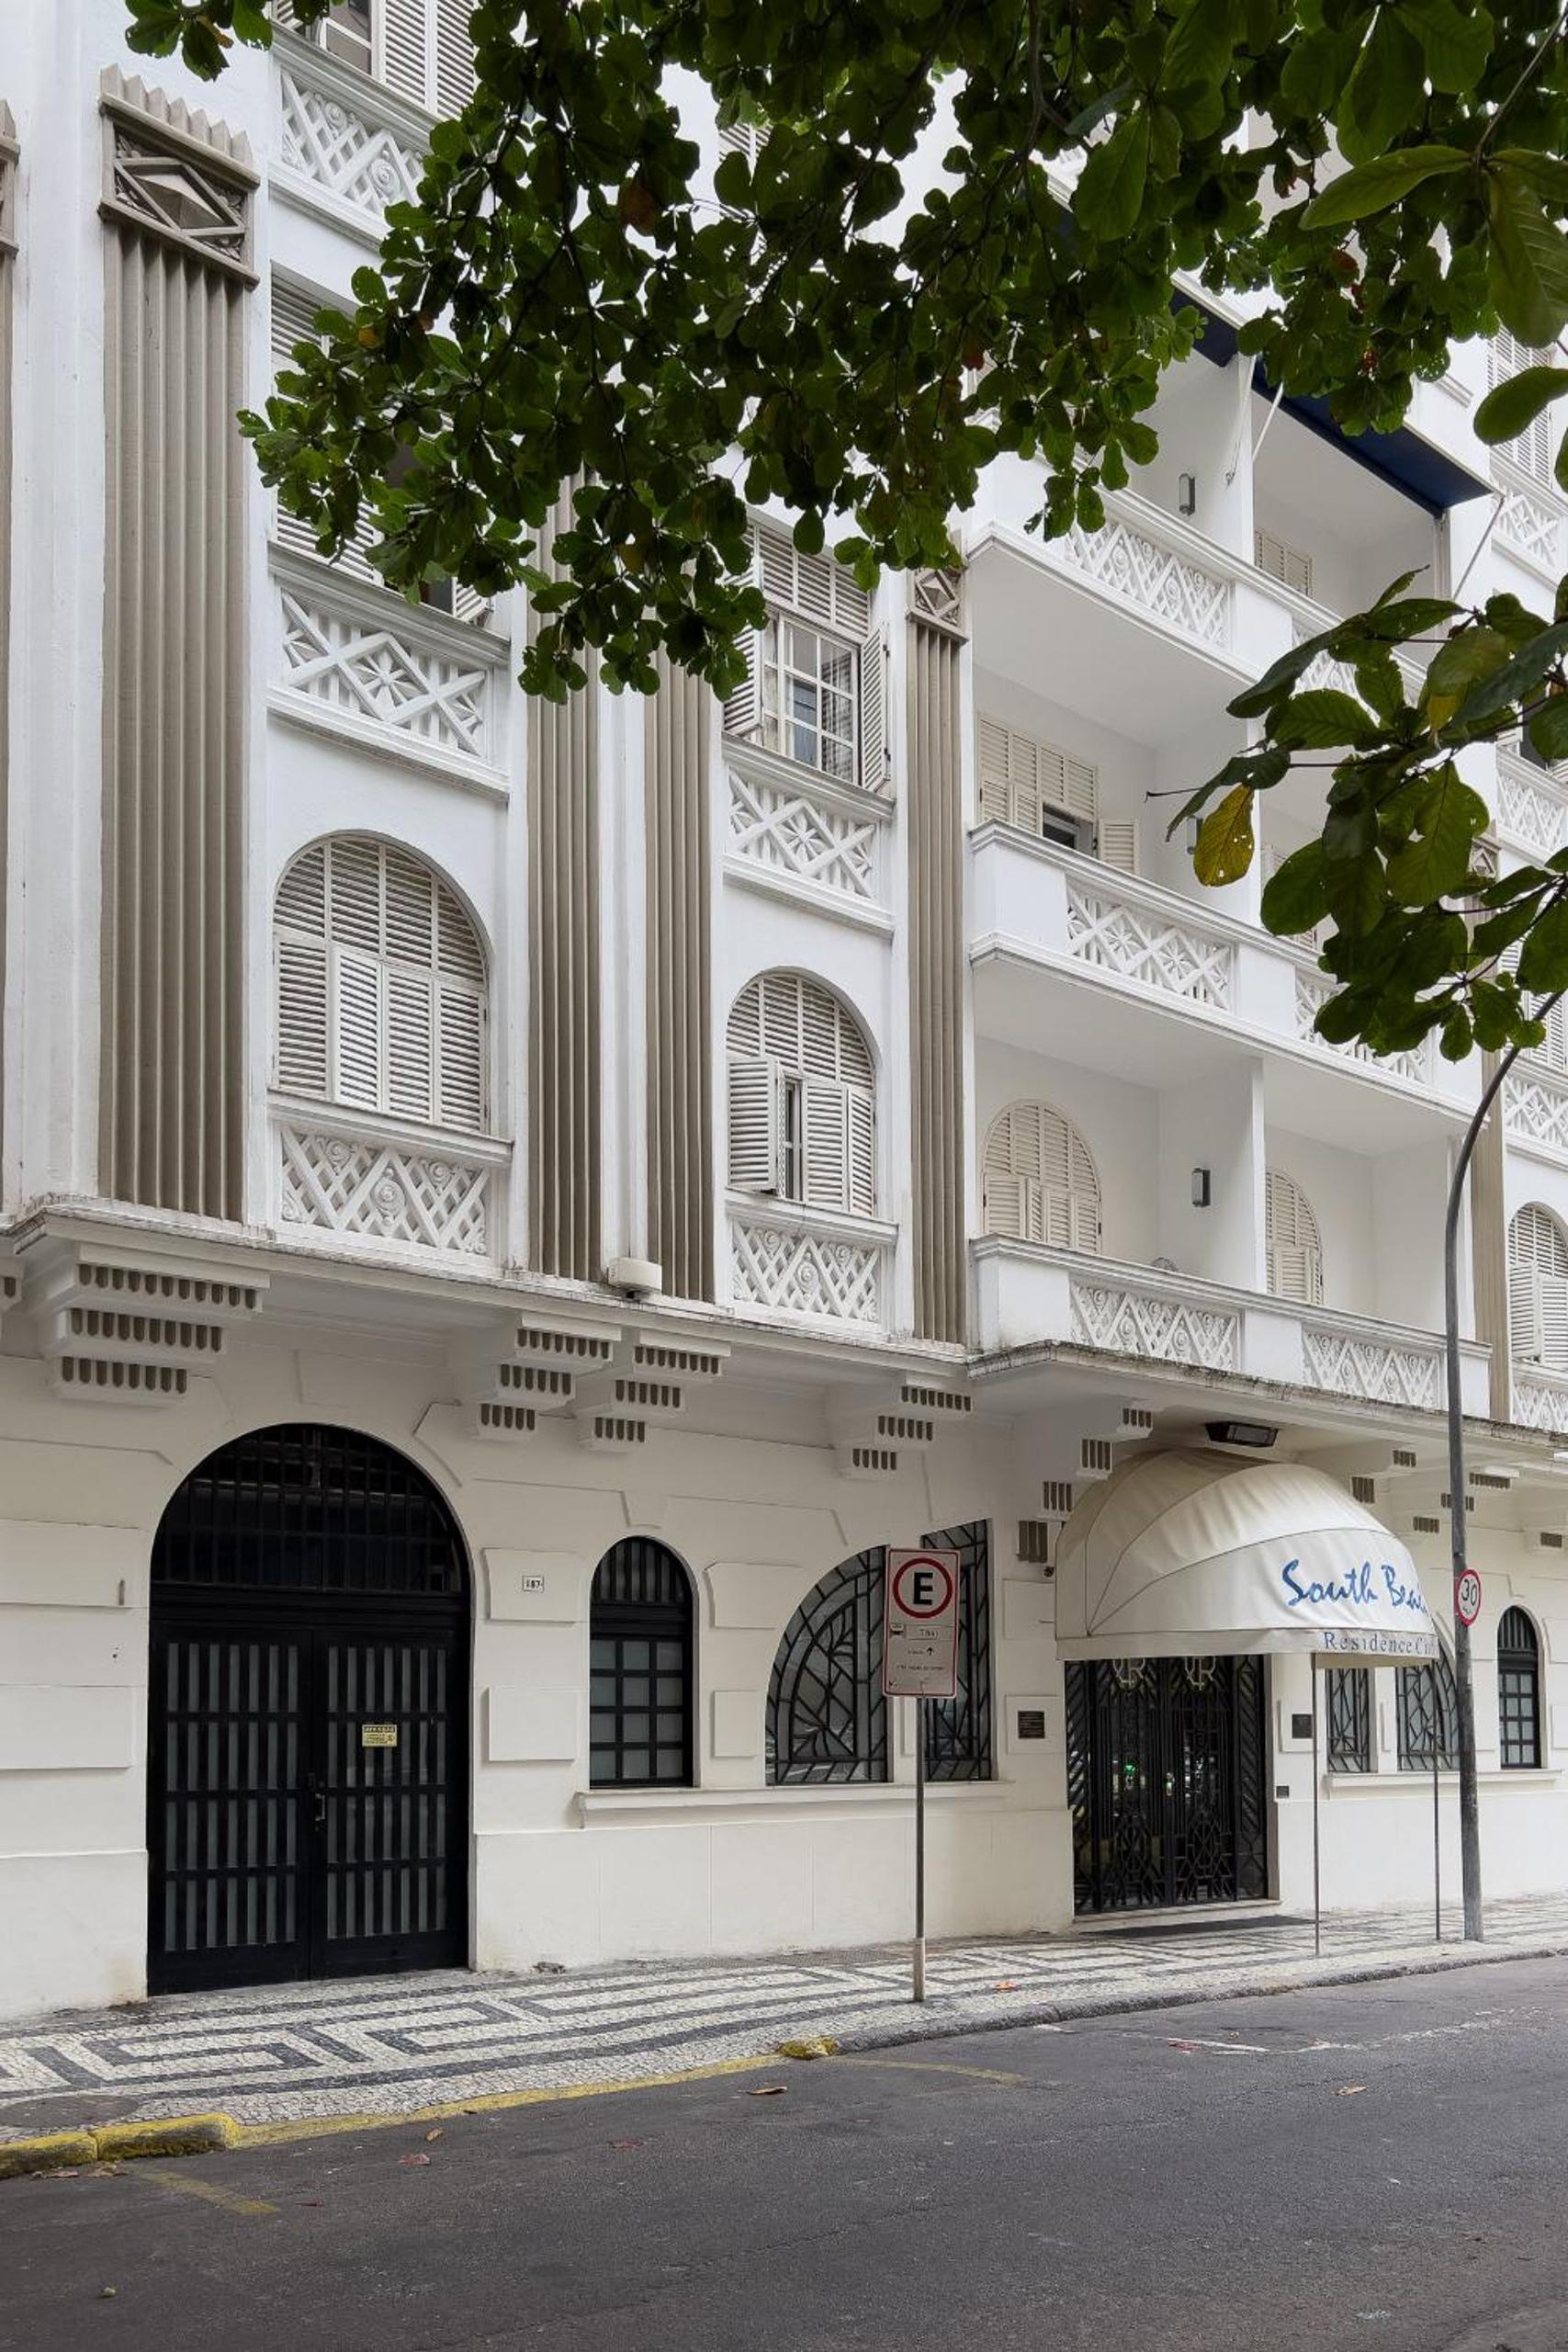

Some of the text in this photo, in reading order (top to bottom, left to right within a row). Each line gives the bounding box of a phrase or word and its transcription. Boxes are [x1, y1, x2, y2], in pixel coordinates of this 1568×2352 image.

[913, 1572, 933, 1605] E
[1282, 1559, 1378, 1606] South
[1461, 1578, 1477, 1606] 30
[1324, 1632, 1413, 1654] Residence
